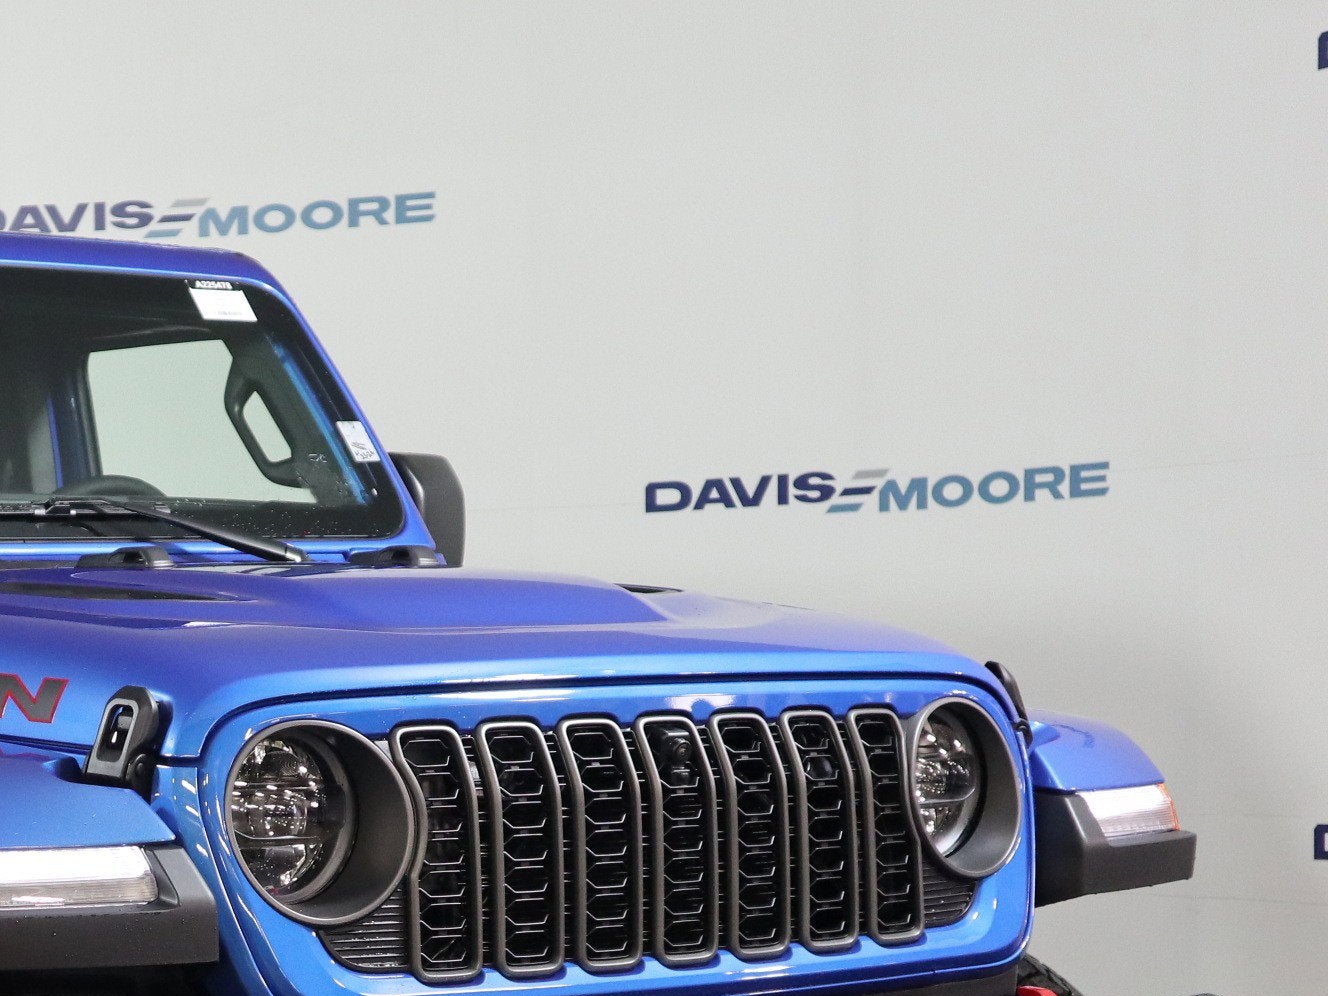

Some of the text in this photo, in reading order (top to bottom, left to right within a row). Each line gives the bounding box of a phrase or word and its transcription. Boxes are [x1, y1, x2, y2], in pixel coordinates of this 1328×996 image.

[197, 191, 437, 238] MOORE
[644, 461, 1110, 513] DAVIS MOORE
